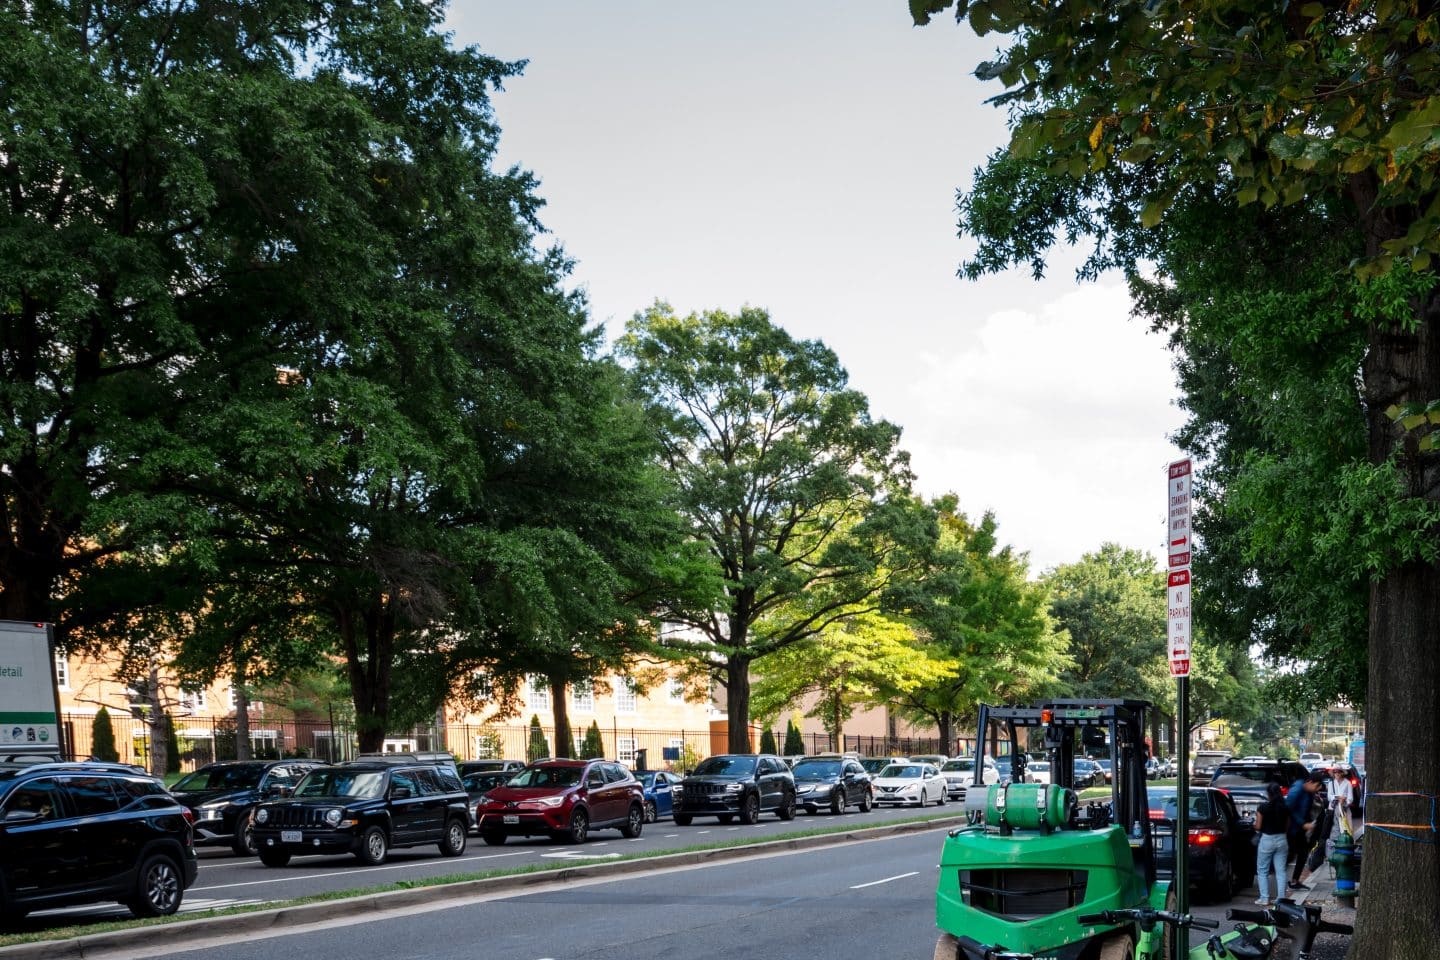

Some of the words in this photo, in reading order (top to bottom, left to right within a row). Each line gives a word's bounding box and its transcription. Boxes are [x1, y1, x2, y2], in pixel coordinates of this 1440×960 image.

[1176, 481, 1184, 492] NO
[1176, 591, 1183, 603] NO
[1169, 606, 1189, 619] PARKING
[1175, 623, 1184, 632] TAXI
